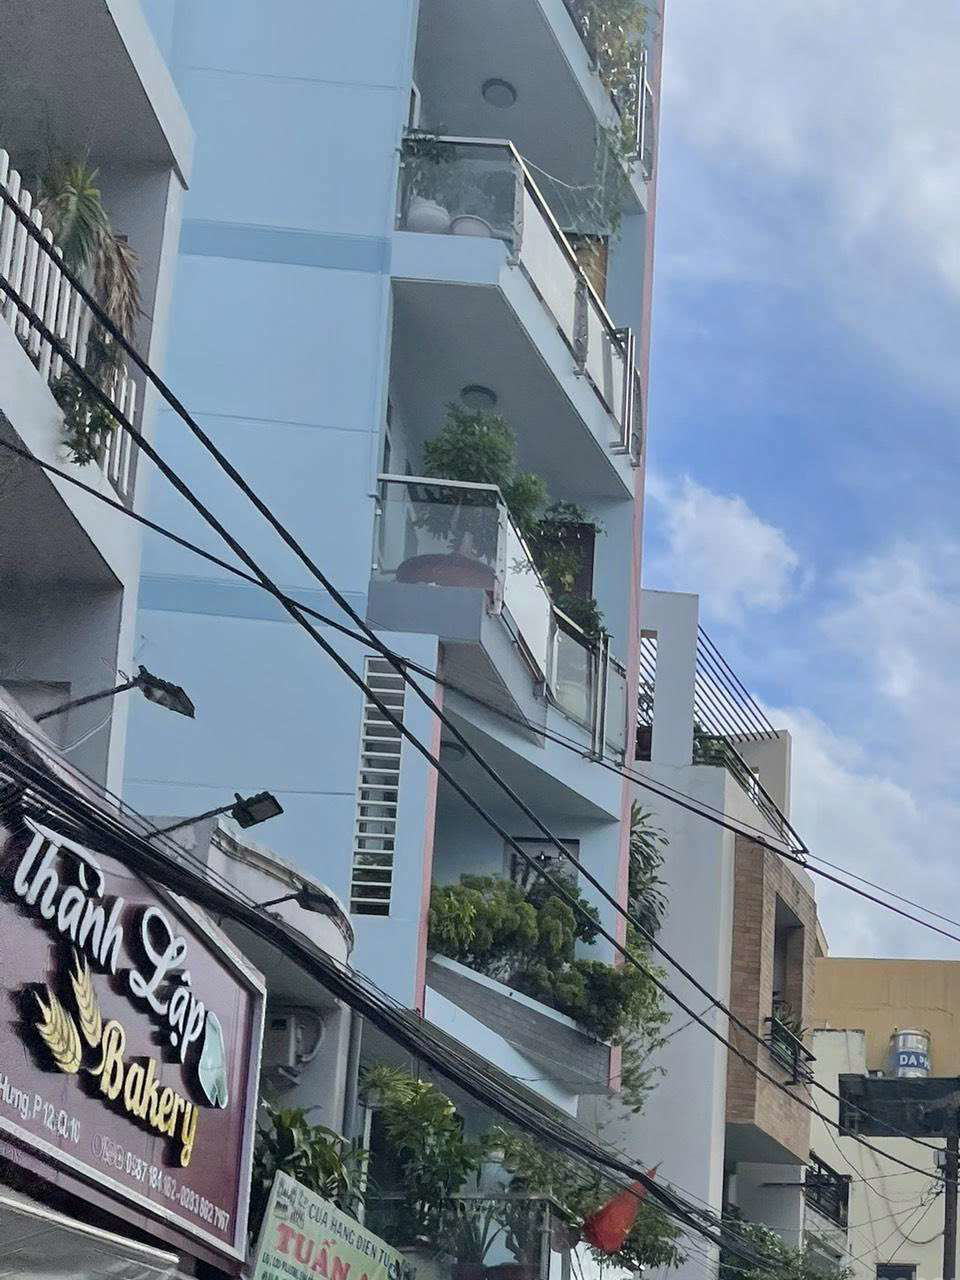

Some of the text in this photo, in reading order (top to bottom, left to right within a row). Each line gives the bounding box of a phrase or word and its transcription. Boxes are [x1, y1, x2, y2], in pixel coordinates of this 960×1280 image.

[14, 816, 205, 1064] Thành Lập
[87, 1020, 199, 1167] Bakery
